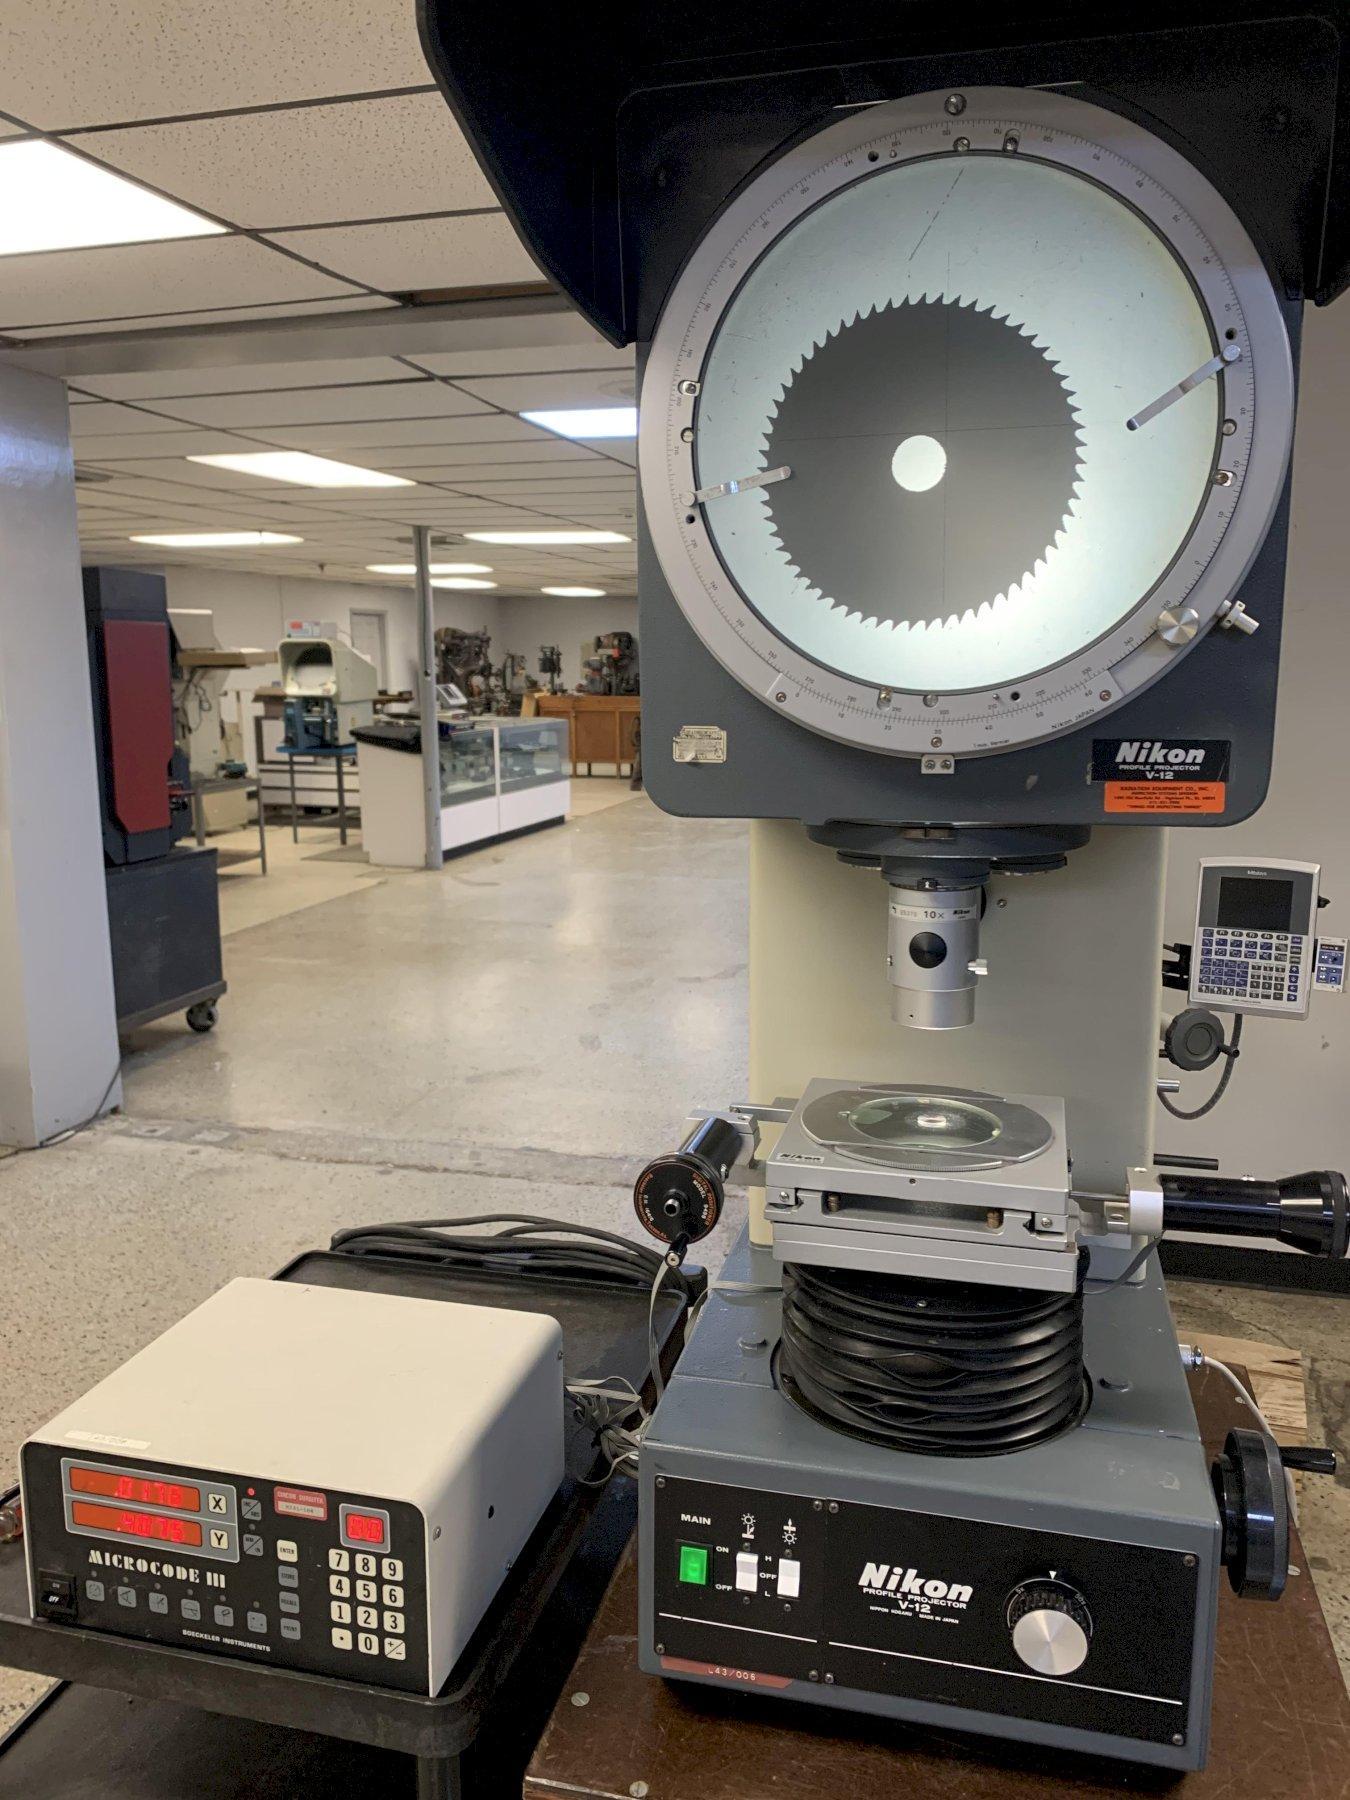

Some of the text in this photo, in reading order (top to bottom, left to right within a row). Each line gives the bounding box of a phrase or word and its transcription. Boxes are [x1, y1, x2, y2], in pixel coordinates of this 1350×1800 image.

[1240, 407, 1246, 416] 30
[1232, 460, 1240, 468] 20
[1218, 510, 1225, 518] 10
[1051, 706, 1095, 730] Nikon JAPAN
[1115, 741, 1206, 764] Nikon
[1146, 771, 1174, 780] V-12
[692, 1180, 706, 1198] MODEL
[212, 1496, 222, 1510] X
[680, 1514, 711, 1525] MAIN
[214, 1534, 224, 1546] Y
[716, 1546, 730, 1554] ON
[88, 1550, 200, 1584] MICROCODE
[336, 1552, 396, 1577] 7 8 9
[759, 1572, 778, 1580] OFF
[858, 1562, 974, 1602] Nikon
[336, 1579, 397, 1603] 4 5 6
[715, 1584, 732, 1592] OFF
[863, 1588, 968, 1610] PROFILE PROJECTOR
[898, 1600, 931, 1614] V-12
[337, 1605, 397, 1629] 1 2 3
[182, 1628, 271, 1652] BOECKELER INSTRUMENTS
[364, 1636, 372, 1651] 0
